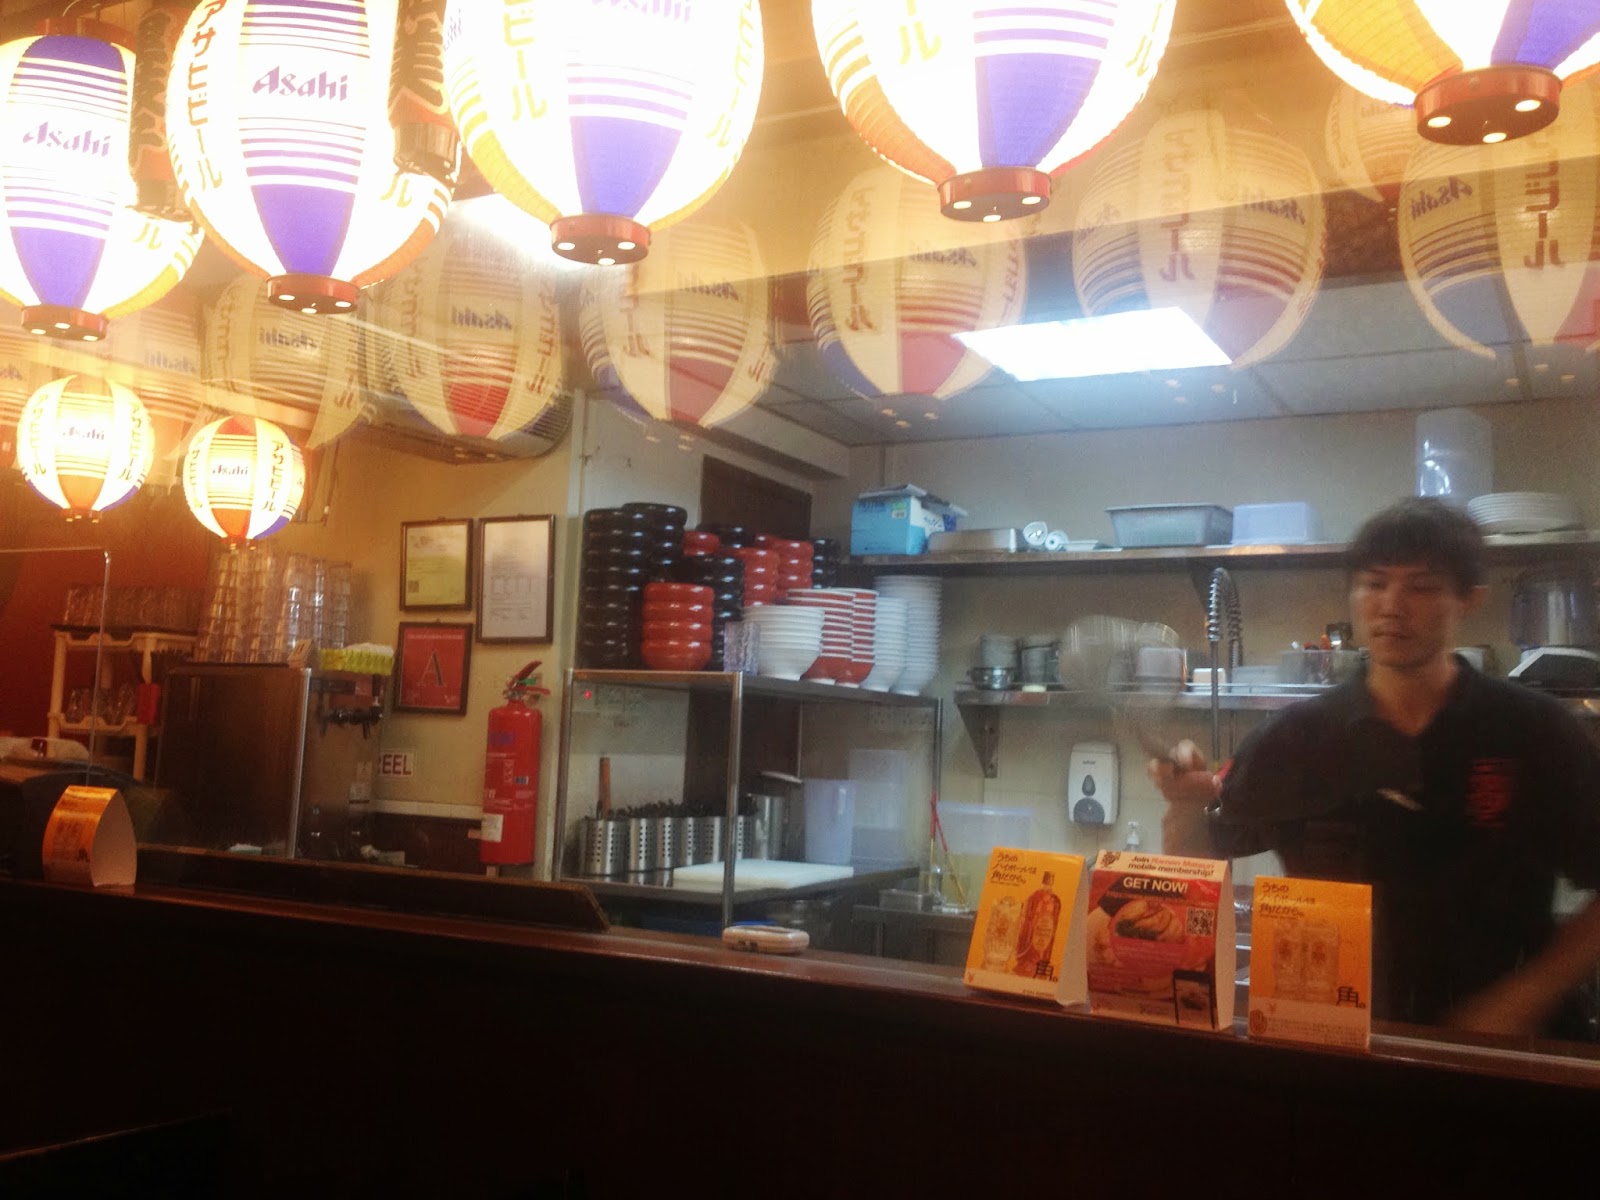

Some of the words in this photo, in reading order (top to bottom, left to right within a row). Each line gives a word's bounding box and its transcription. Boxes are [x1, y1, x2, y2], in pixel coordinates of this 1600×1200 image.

[252, 66, 349, 101] Asahi
[22, 121, 111, 157] Asahi
[212, 464, 249, 476] Asahi
[416, 647, 447, 688] A
[378, 754, 412, 776] EEL
[1123, 877, 1150, 889] GET
[1151, 880, 1189, 894] NOW!
